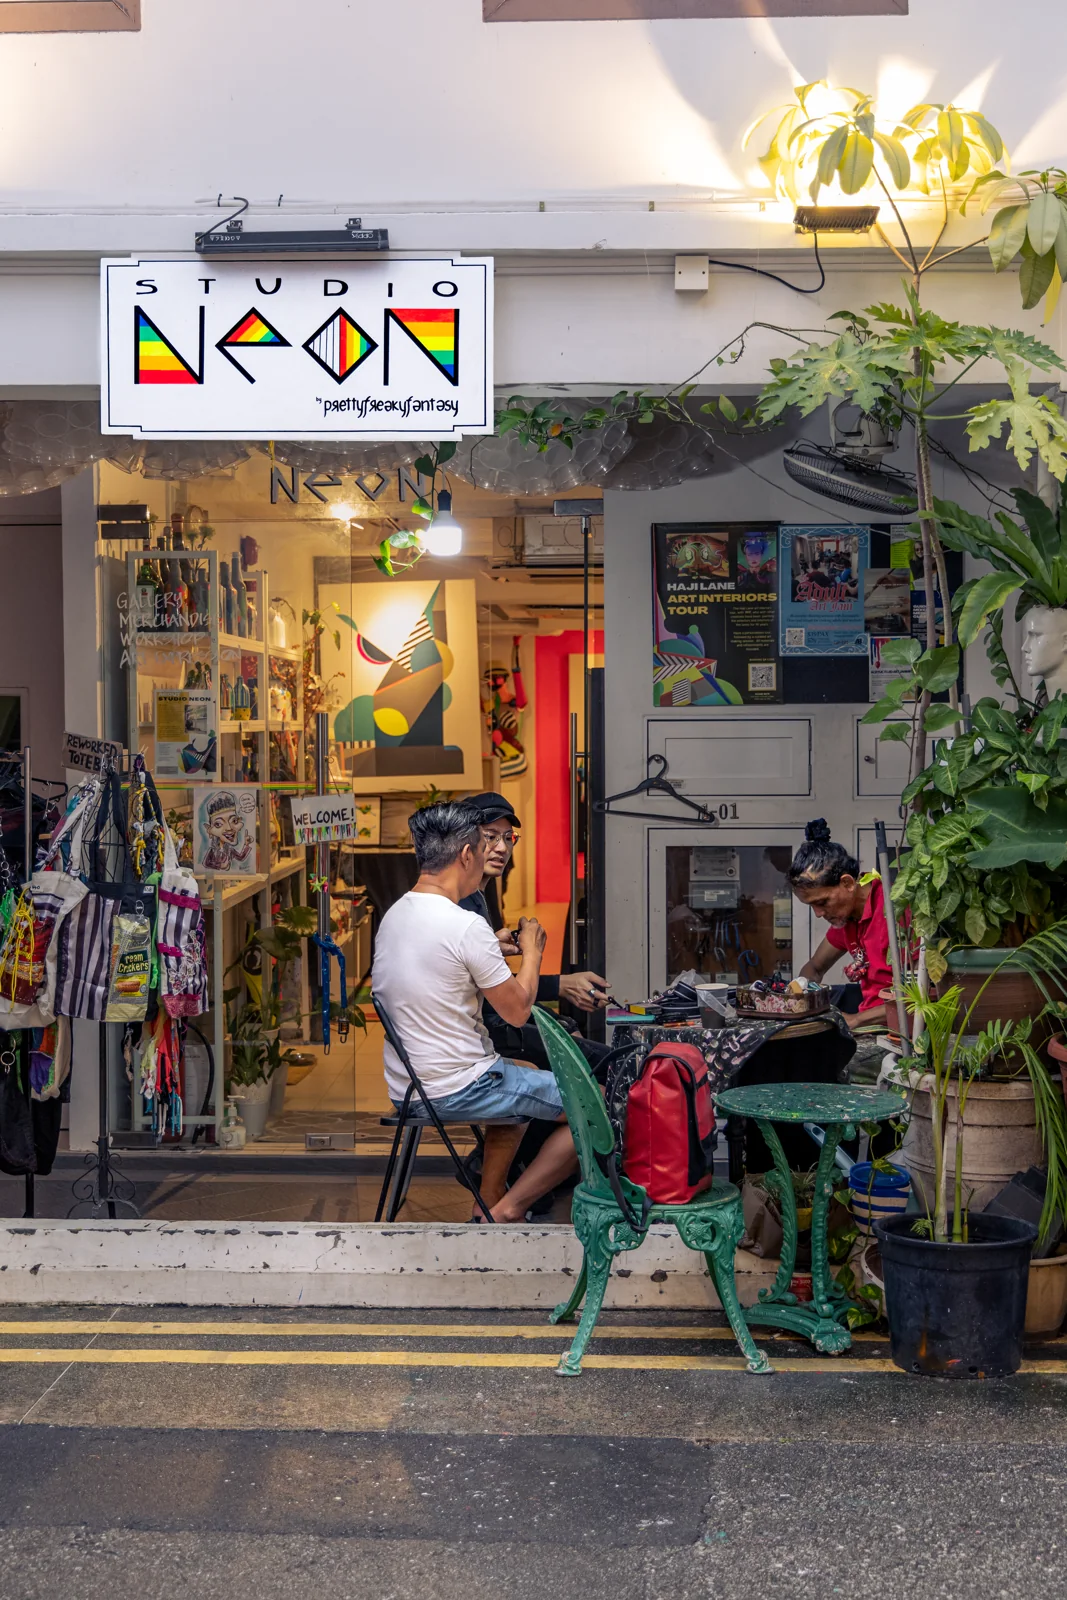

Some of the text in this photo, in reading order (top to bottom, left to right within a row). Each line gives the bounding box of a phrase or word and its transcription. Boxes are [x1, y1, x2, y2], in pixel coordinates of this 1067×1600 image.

[135, 277, 460, 298] STUDIO
[667, 582, 736, 591] HAJI LANE
[794, 579, 849, 601] Adult
[116, 591, 183, 615] GALLERY
[667, 592, 777, 604] ART INTERIORS
[667, 606, 709, 615] TOUR
[119, 631, 206, 647] WORKSHOP
[67, 734, 118, 758] REWORKED
[293, 807, 355, 826] WELCOME!
